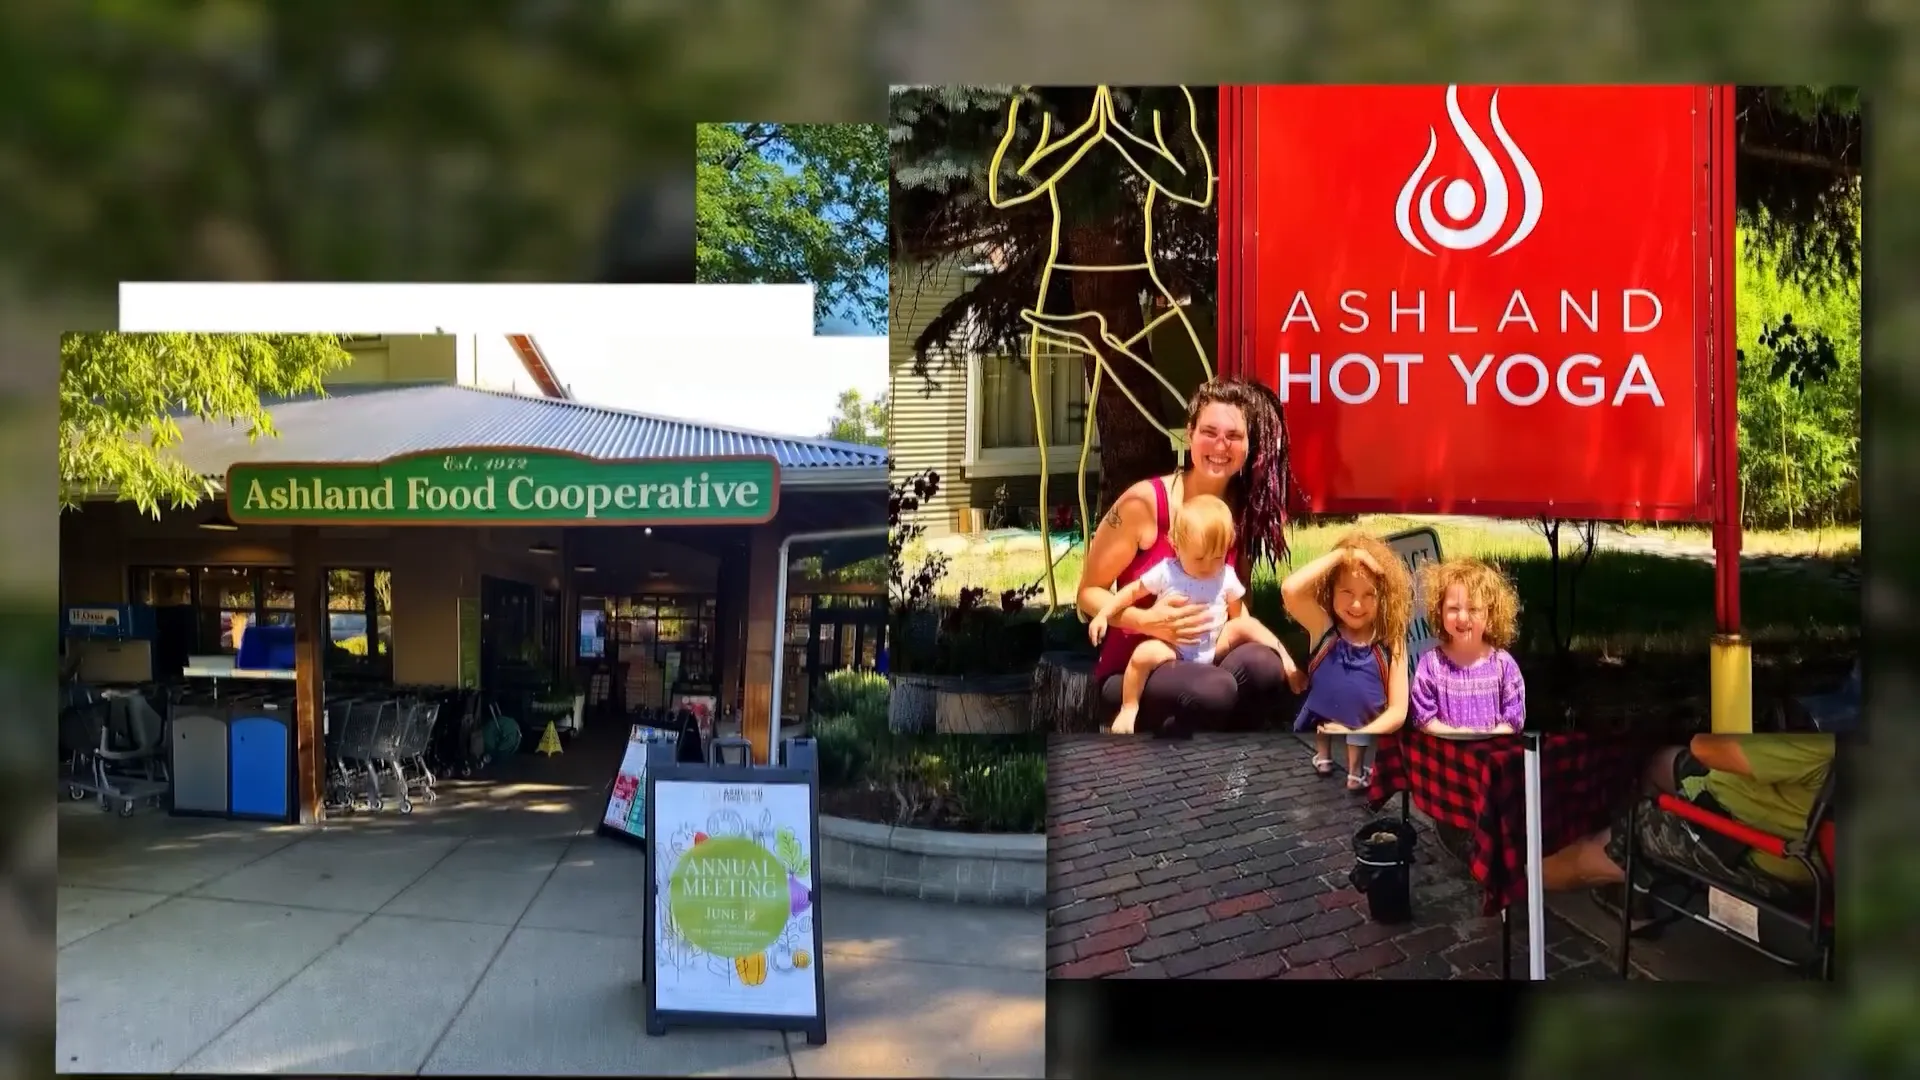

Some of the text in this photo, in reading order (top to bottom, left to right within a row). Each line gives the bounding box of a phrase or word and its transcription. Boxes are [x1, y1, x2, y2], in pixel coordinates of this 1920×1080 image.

[1280, 289, 1663, 334] ASHLAND
[1278, 352, 1666, 408] HOT YOGA
[243, 472, 760, 519] Ashland Food Cooperative
[685, 856, 776, 878] ANNUAL
[683, 877, 777, 898] MEETING
[704, 906, 740, 921] JUNE
